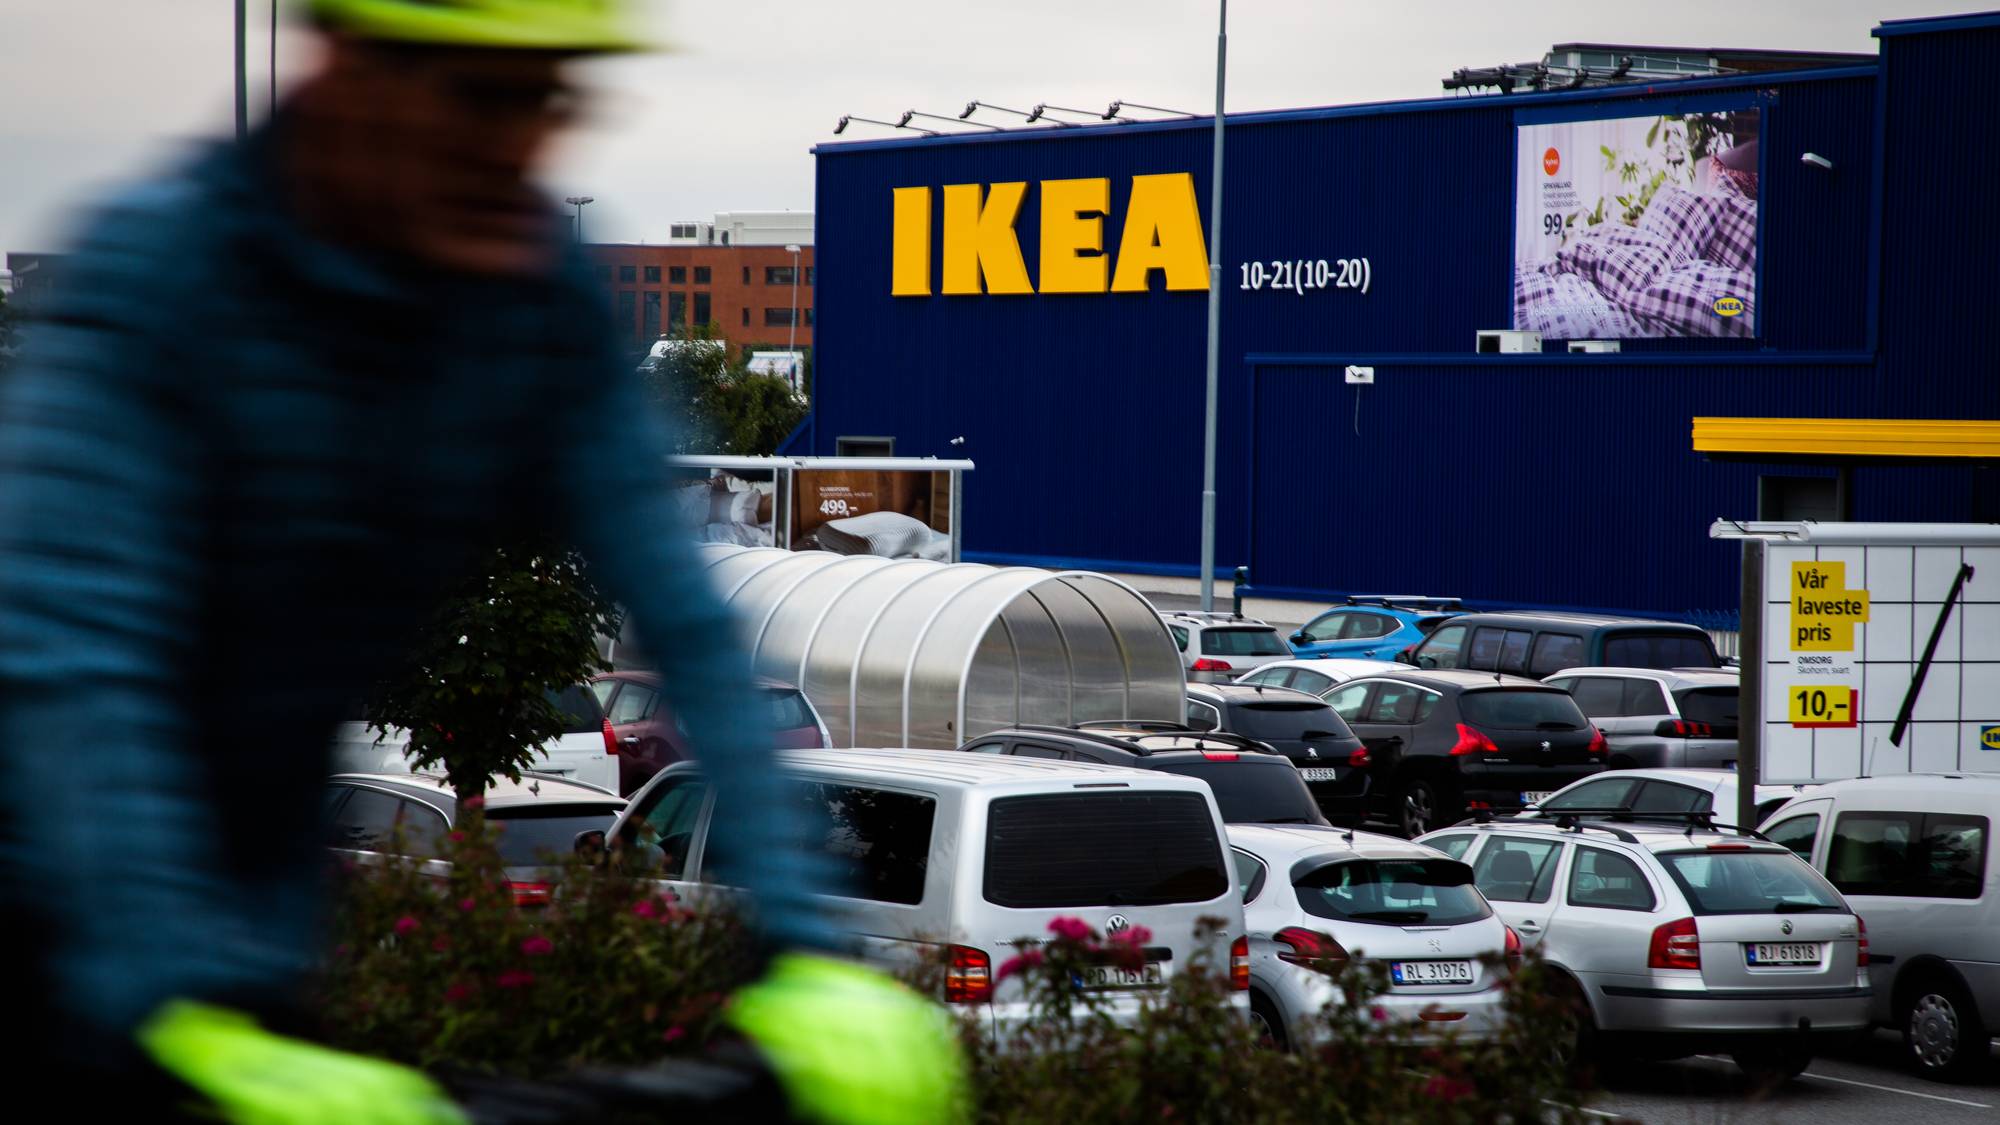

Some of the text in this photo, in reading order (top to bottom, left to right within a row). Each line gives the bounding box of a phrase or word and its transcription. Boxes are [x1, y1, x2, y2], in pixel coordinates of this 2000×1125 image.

[891, 172, 1210, 297] IKEA
[1240, 257, 1371, 295] 10-21(10-20)
[1716, 302, 1741, 310] IKEA
[1797, 568, 1829, 589] Vår
[1798, 596, 1862, 615] laveste
[1797, 622, 1832, 647] pris
[1797, 656, 1832, 664] OMSORG
[1780, 945, 1815, 960] 61818
[1406, 963, 1467, 979] RL 31976
